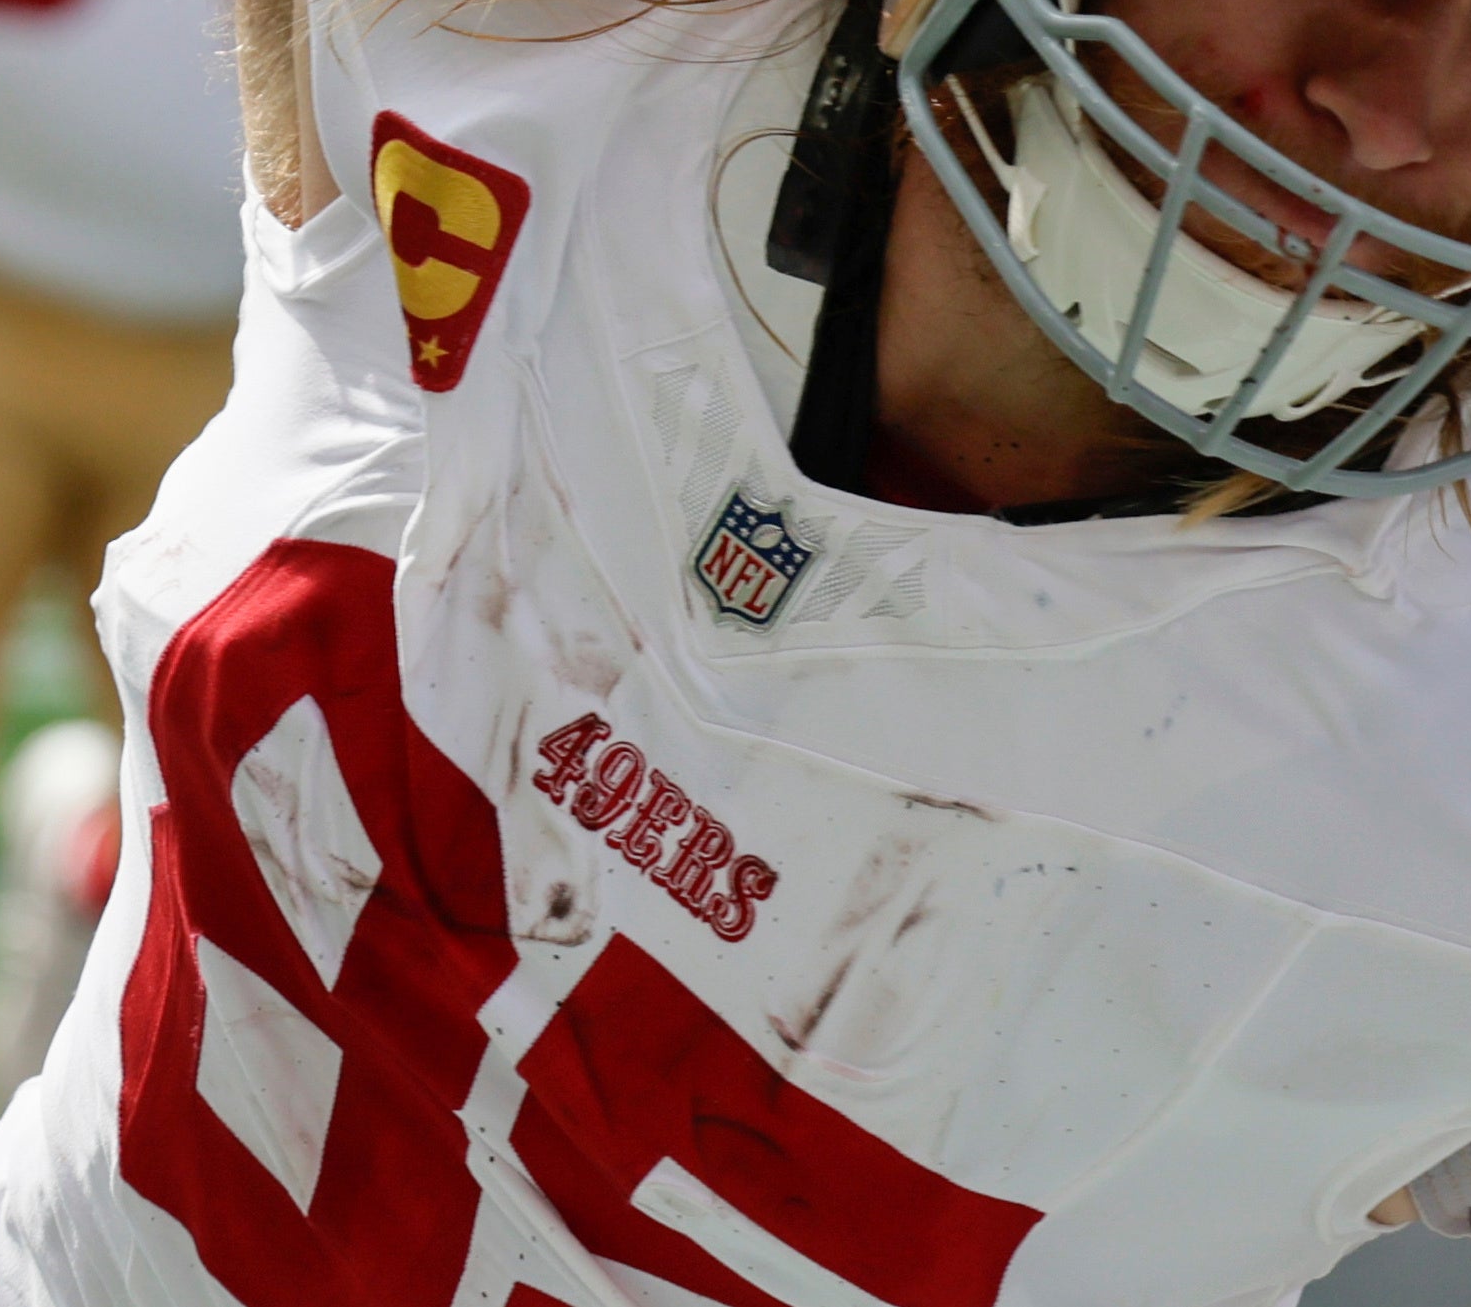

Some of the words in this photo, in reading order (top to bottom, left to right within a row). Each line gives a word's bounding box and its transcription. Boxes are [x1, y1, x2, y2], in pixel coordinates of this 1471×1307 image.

[373, 138, 502, 321] C
[703, 532, 778, 616] NFL
[531, 711, 781, 944] 49ERS
